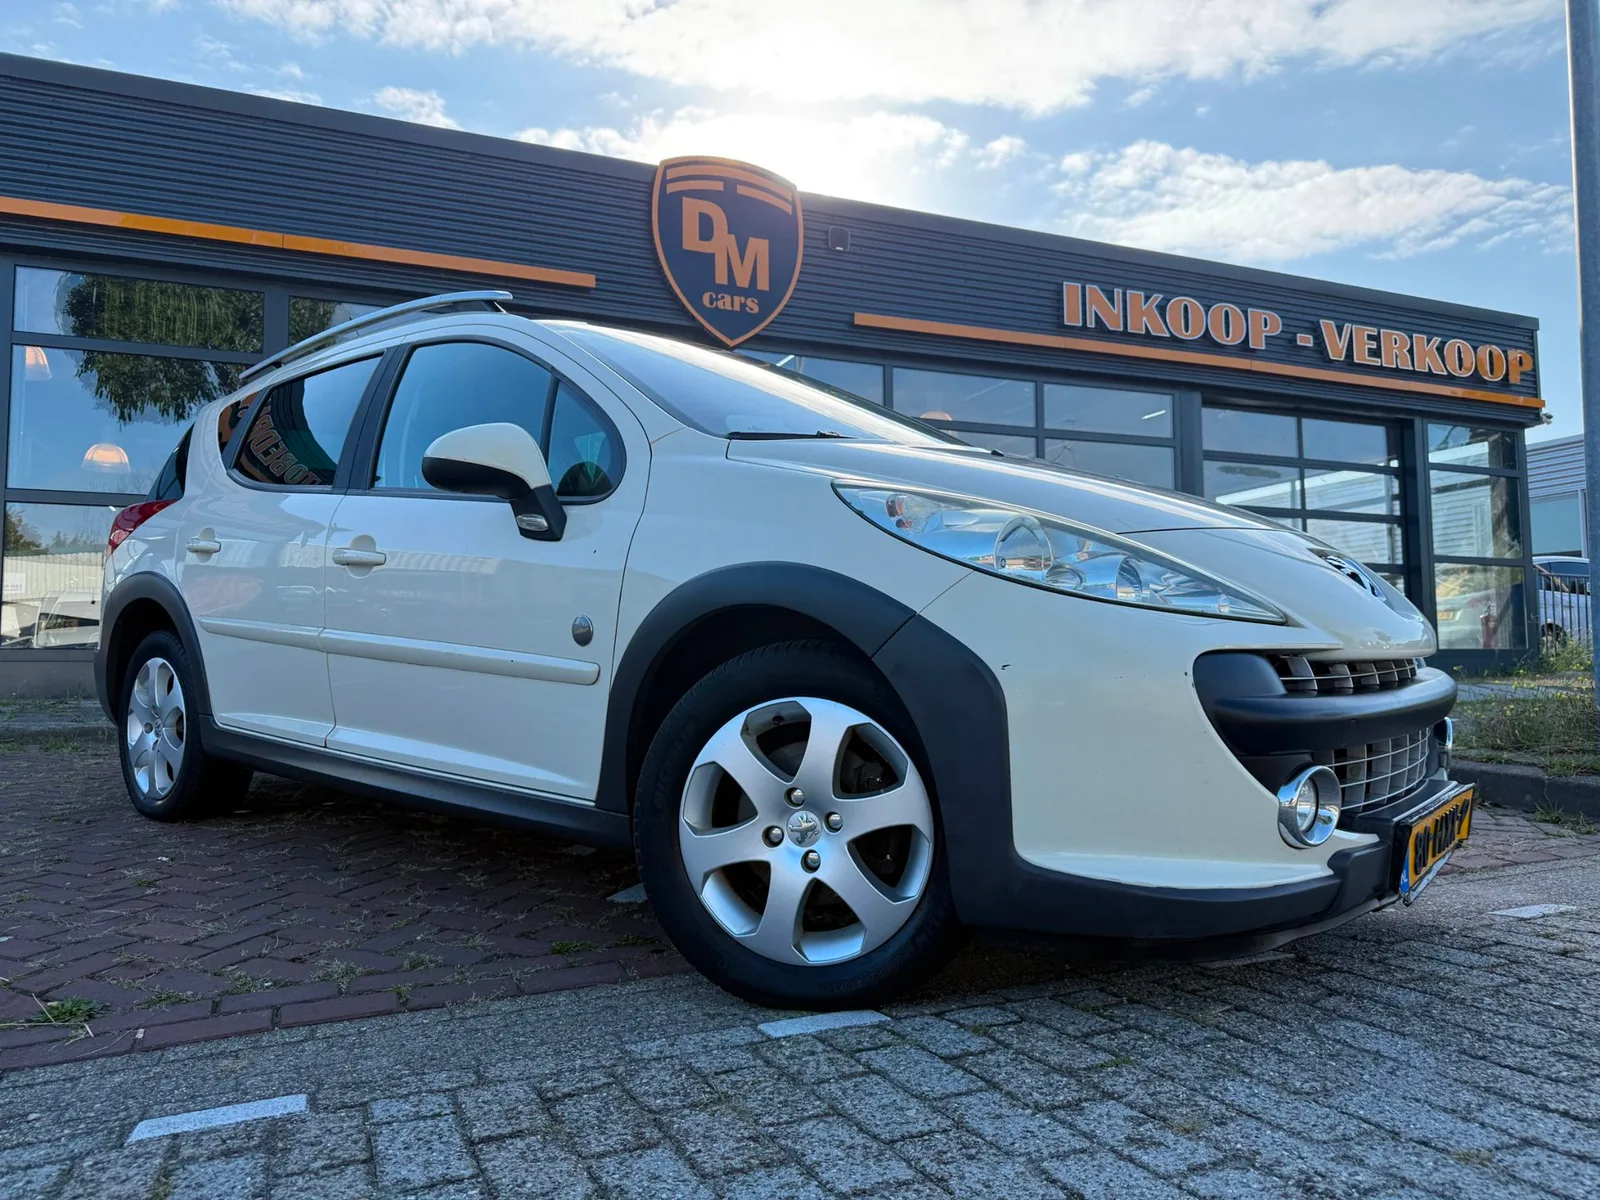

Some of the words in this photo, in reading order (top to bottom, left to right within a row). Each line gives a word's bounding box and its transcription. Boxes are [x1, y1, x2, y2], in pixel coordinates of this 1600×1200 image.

[682, 196, 770, 292] DM
[702, 291, 760, 314] cars
[1062, 280, 1283, 350] INKOOP
[1318, 318, 1535, 385] VERKOOP
